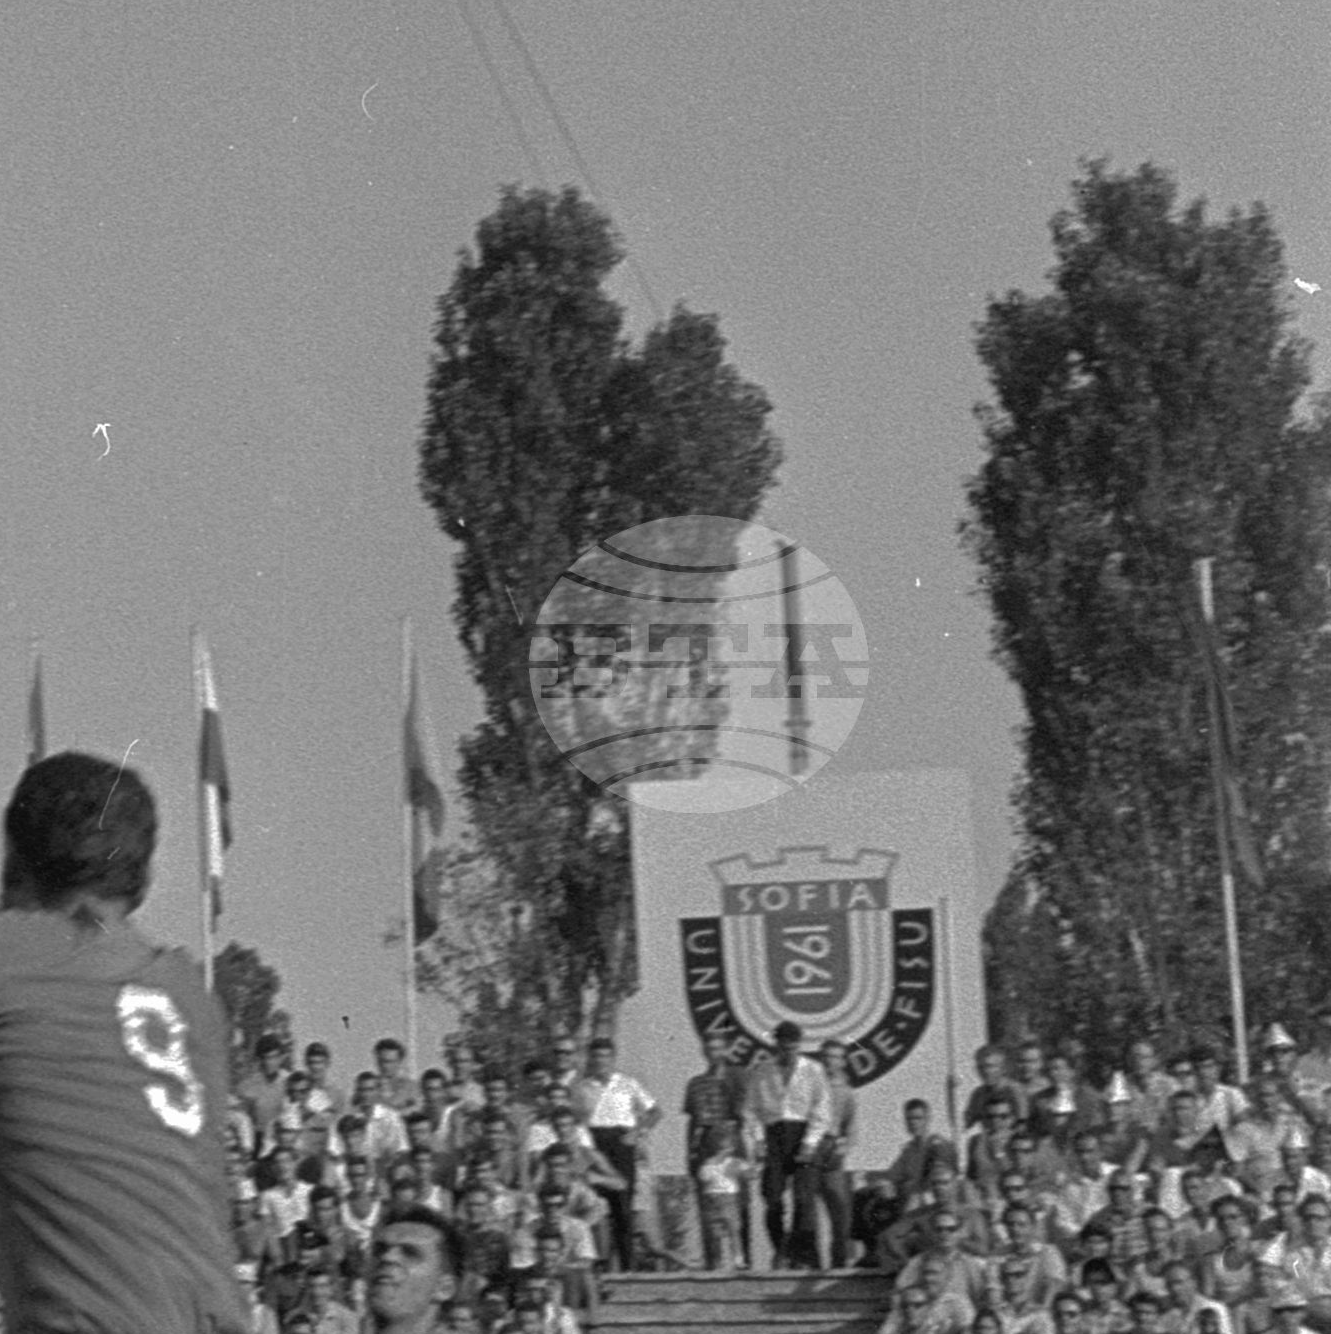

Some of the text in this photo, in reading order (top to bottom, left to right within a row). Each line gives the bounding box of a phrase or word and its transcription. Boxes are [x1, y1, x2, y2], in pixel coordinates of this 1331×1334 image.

[738, 883, 878, 913] SOFIA
[781, 924, 833, 995] 1961
[116, 983, 205, 1136] 9
